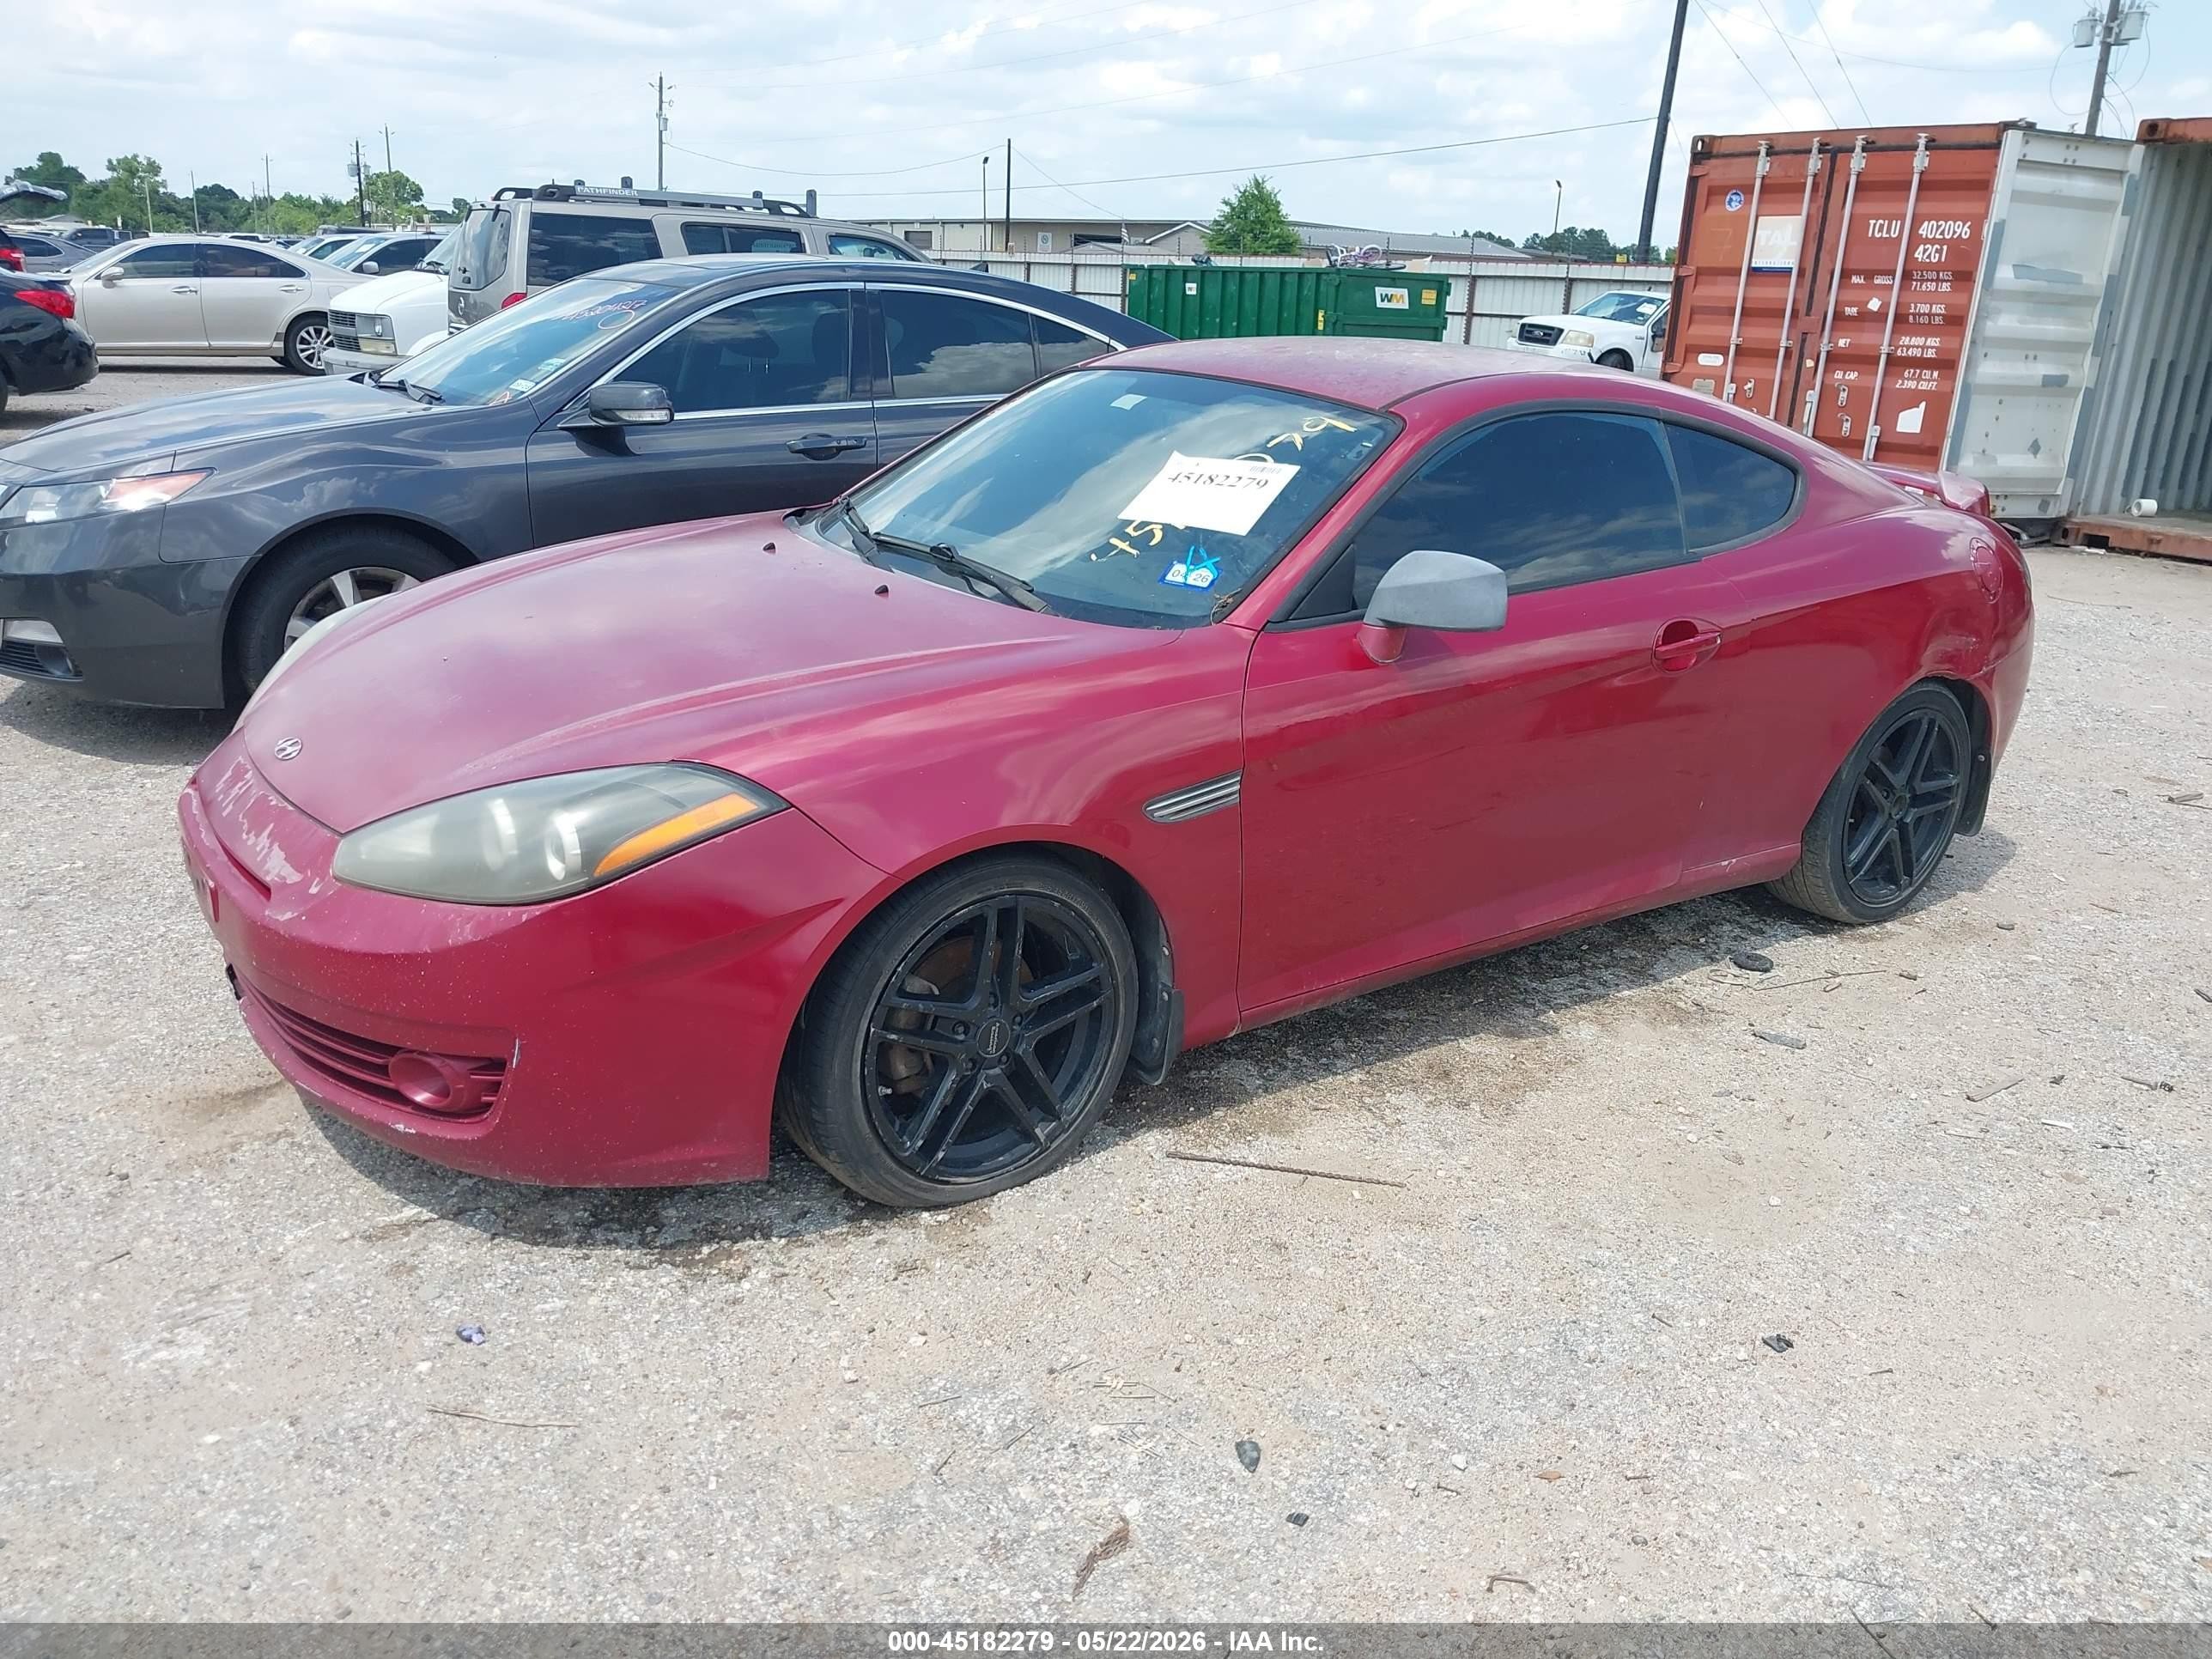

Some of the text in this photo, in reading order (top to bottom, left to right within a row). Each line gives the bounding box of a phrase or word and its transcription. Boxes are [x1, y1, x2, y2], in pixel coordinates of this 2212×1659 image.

[577, 186, 638, 196] PATHFINDER
[1869, 220, 1901, 238] TCLU
[1918, 221, 1972, 240] 402096
[1914, 245, 1948, 263] 42G1
[1874, 275, 1894, 285] GROSS
[1911, 282, 1936, 291] 71.650
[1380, 293, 1405, 303] WM
[1909, 303, 1930, 313] 3.700
[1838, 338, 1850, 347] NET
[1897, 347, 1922, 356] 63.490
[1904, 368, 1920, 379] 67.7
[1168, 471, 1268, 489] 45182279
[1192, 573, 1211, 583] 26
